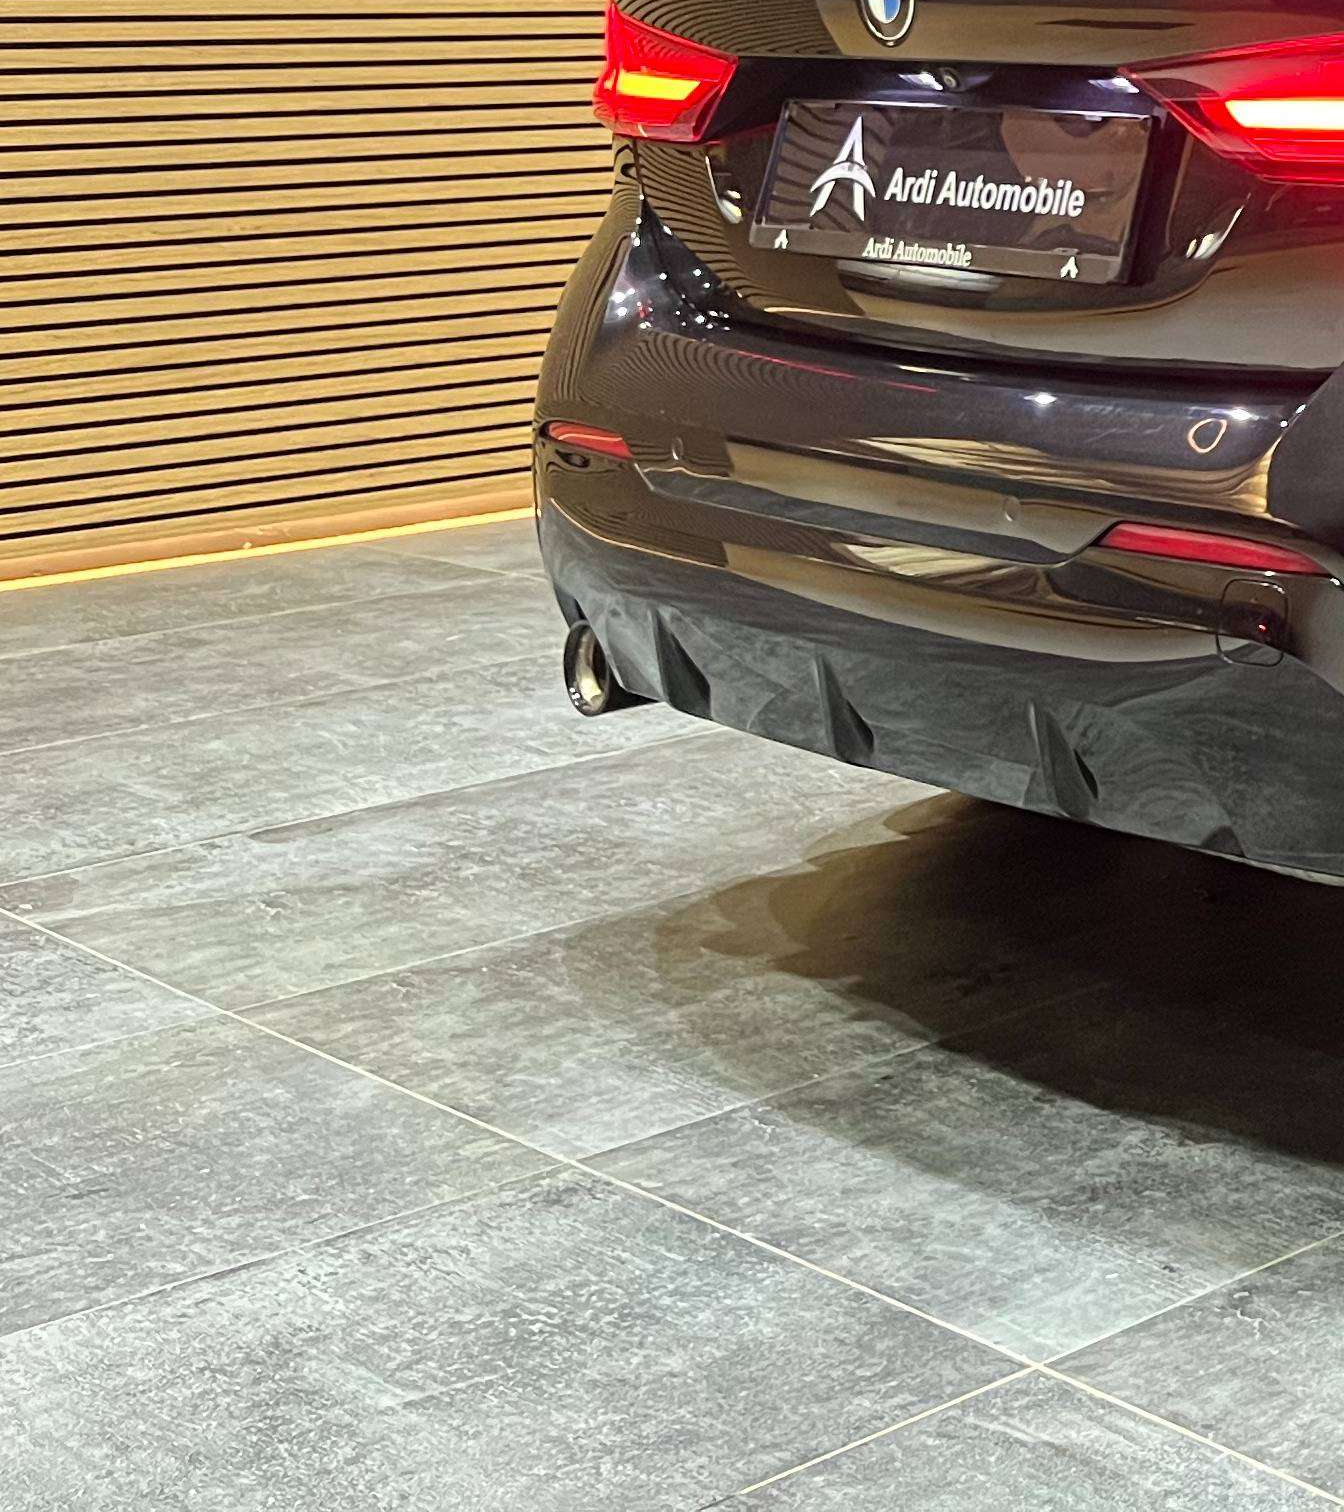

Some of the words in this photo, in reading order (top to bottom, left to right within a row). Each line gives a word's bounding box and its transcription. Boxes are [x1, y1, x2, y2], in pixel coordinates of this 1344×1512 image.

[884, 167, 938, 205] Ardi
[936, 170, 1086, 218] Automobile
[862, 236, 895, 259] Ardi
[894, 239, 973, 267] Automobile
